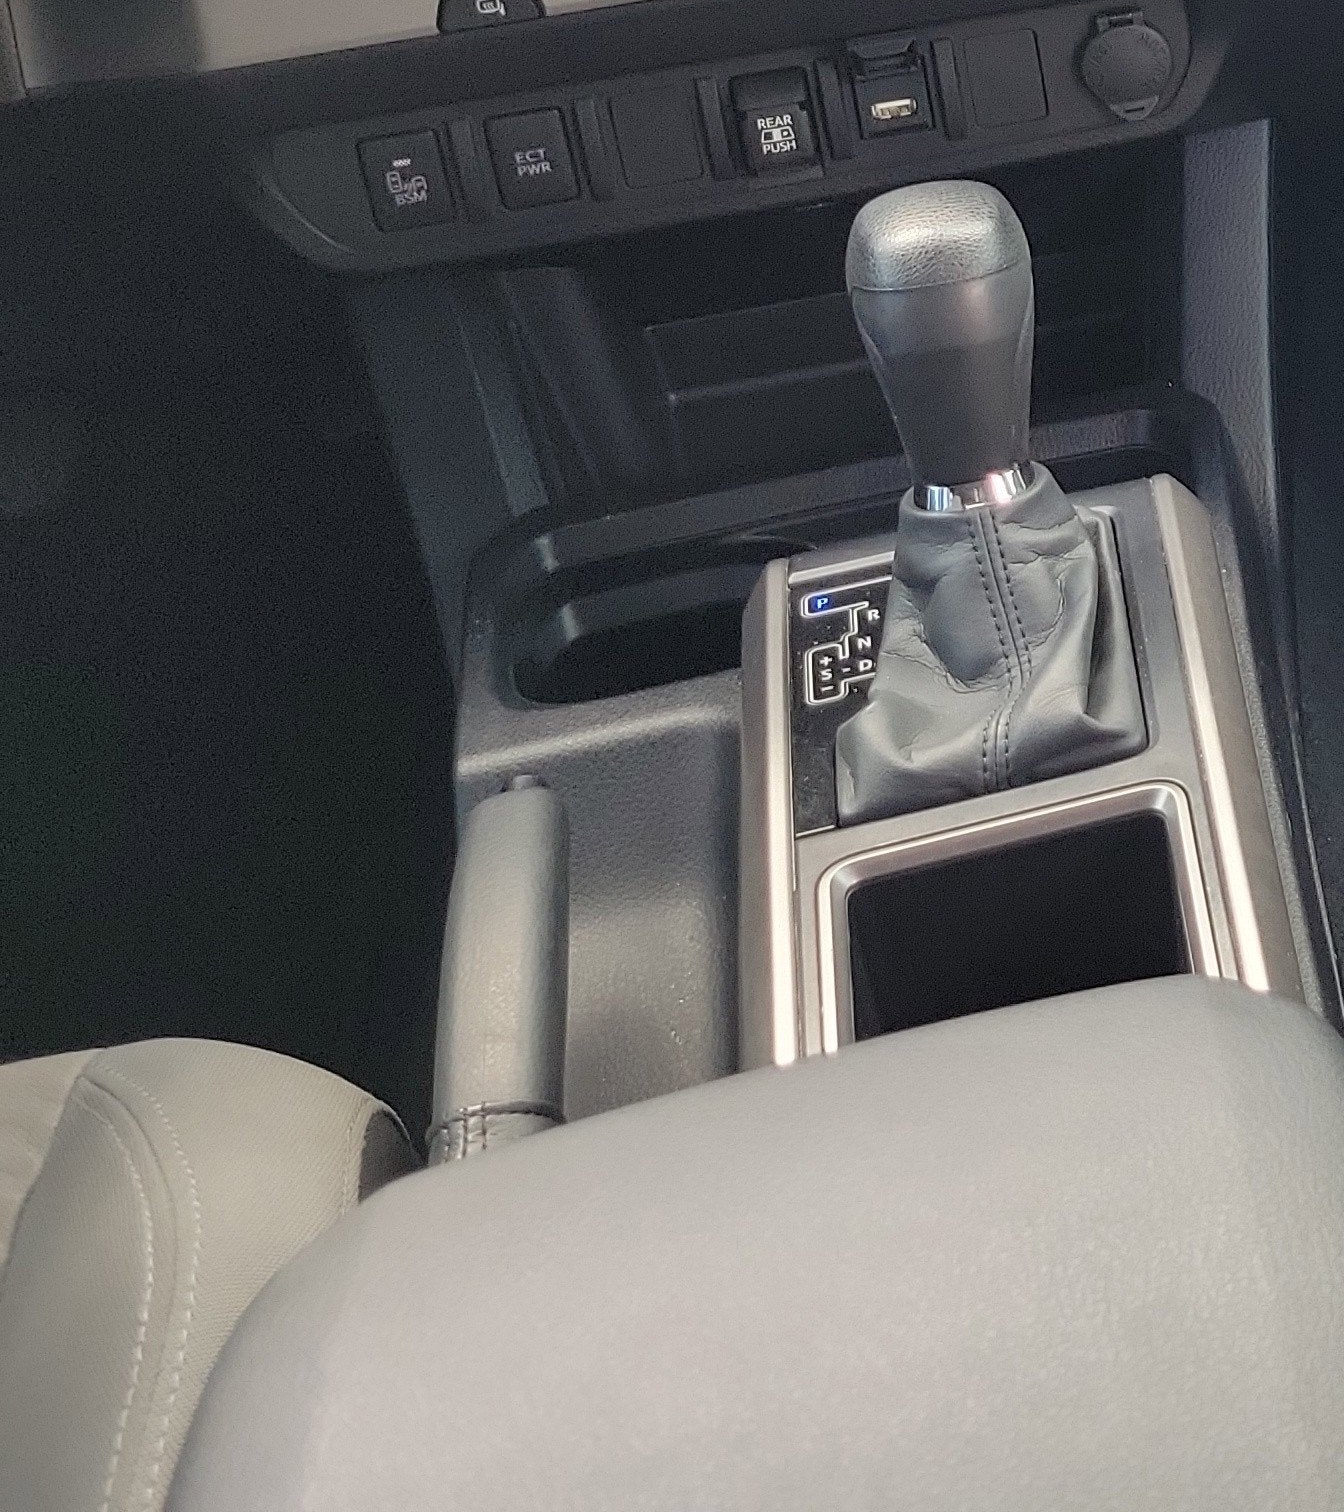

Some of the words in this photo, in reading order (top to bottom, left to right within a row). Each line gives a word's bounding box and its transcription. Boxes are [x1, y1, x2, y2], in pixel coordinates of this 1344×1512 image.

[757, 114, 794, 130] REAR
[762, 139, 798, 155] PUSH
[514, 148, 546, 164] ECT
[516, 161, 552, 177] PWR
[816, 597, 830, 610] P
[867, 609, 881, 621] R
[857, 636, 872, 650] N
[820, 668, 833, 681] S
[859, 659, 874, 673] D
